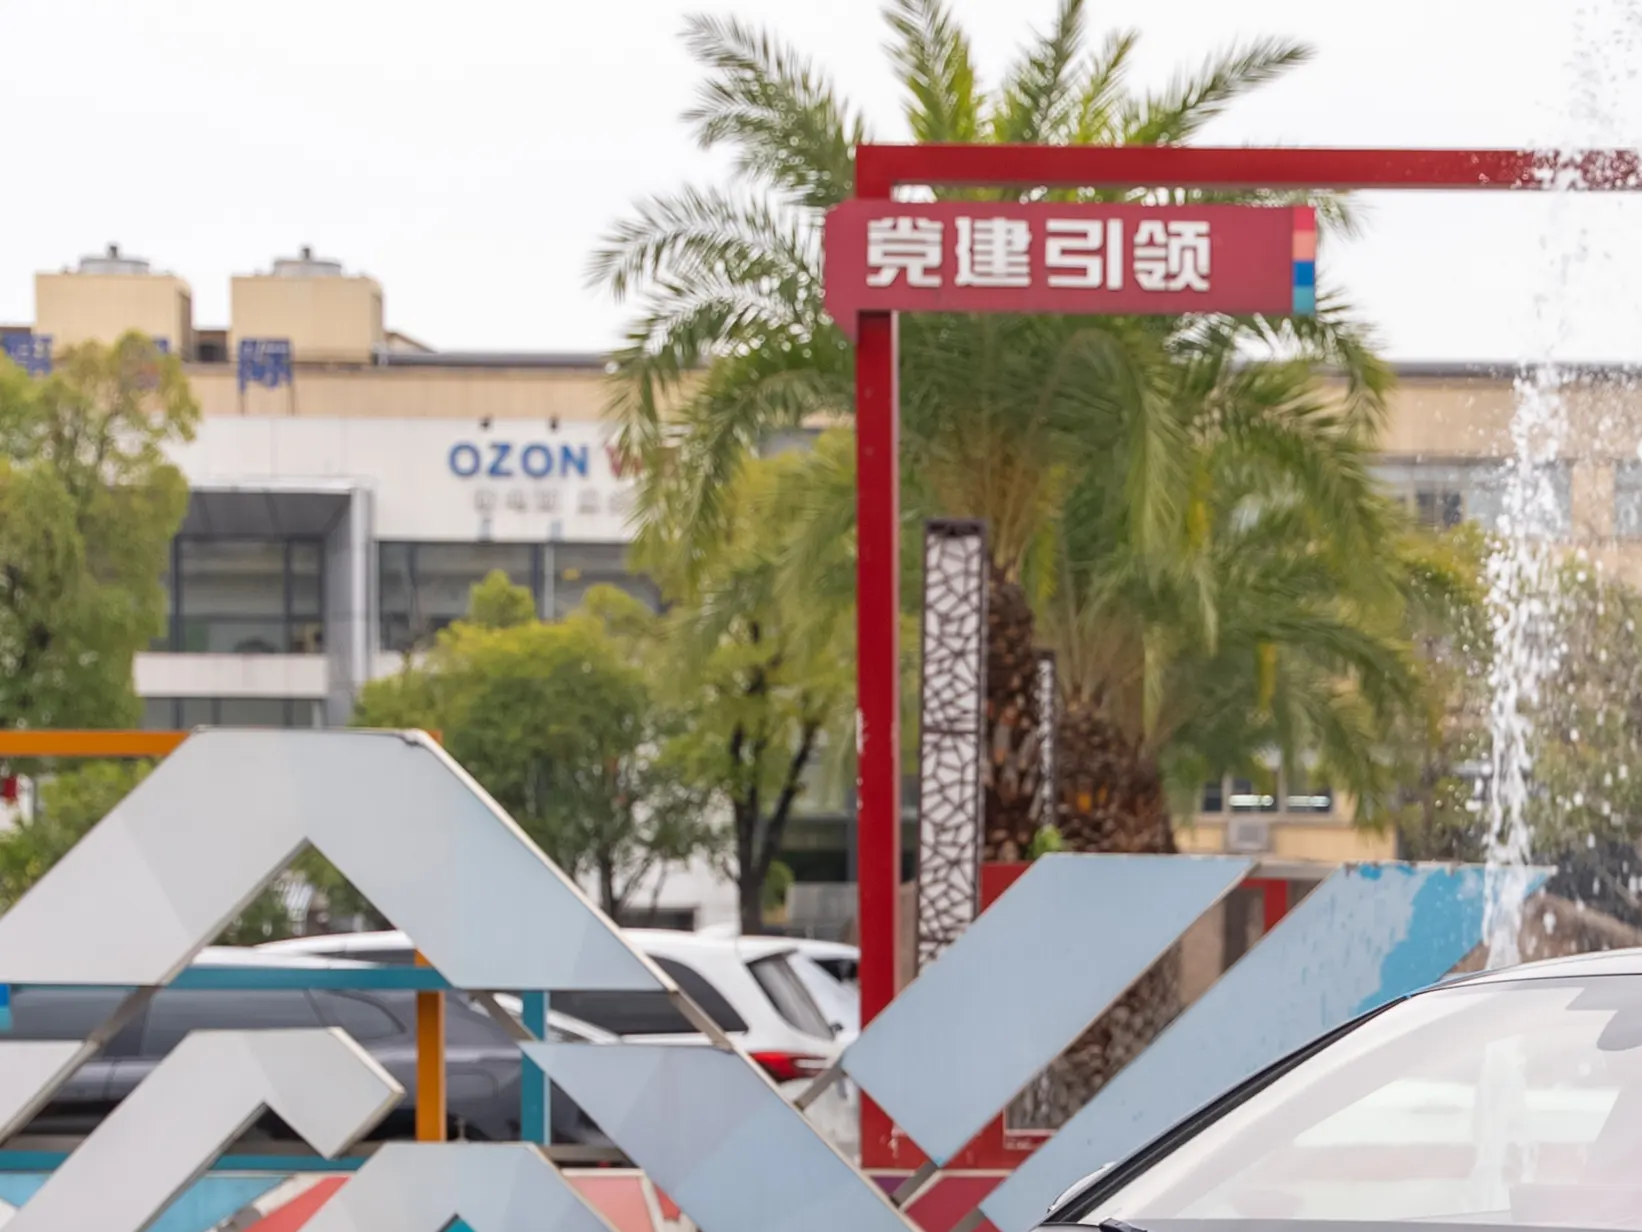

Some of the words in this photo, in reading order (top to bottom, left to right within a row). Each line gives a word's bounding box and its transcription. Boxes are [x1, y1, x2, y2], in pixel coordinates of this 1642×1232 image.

[866, 216, 1210, 291] 党建引领
[448, 442, 589, 478] OZON
